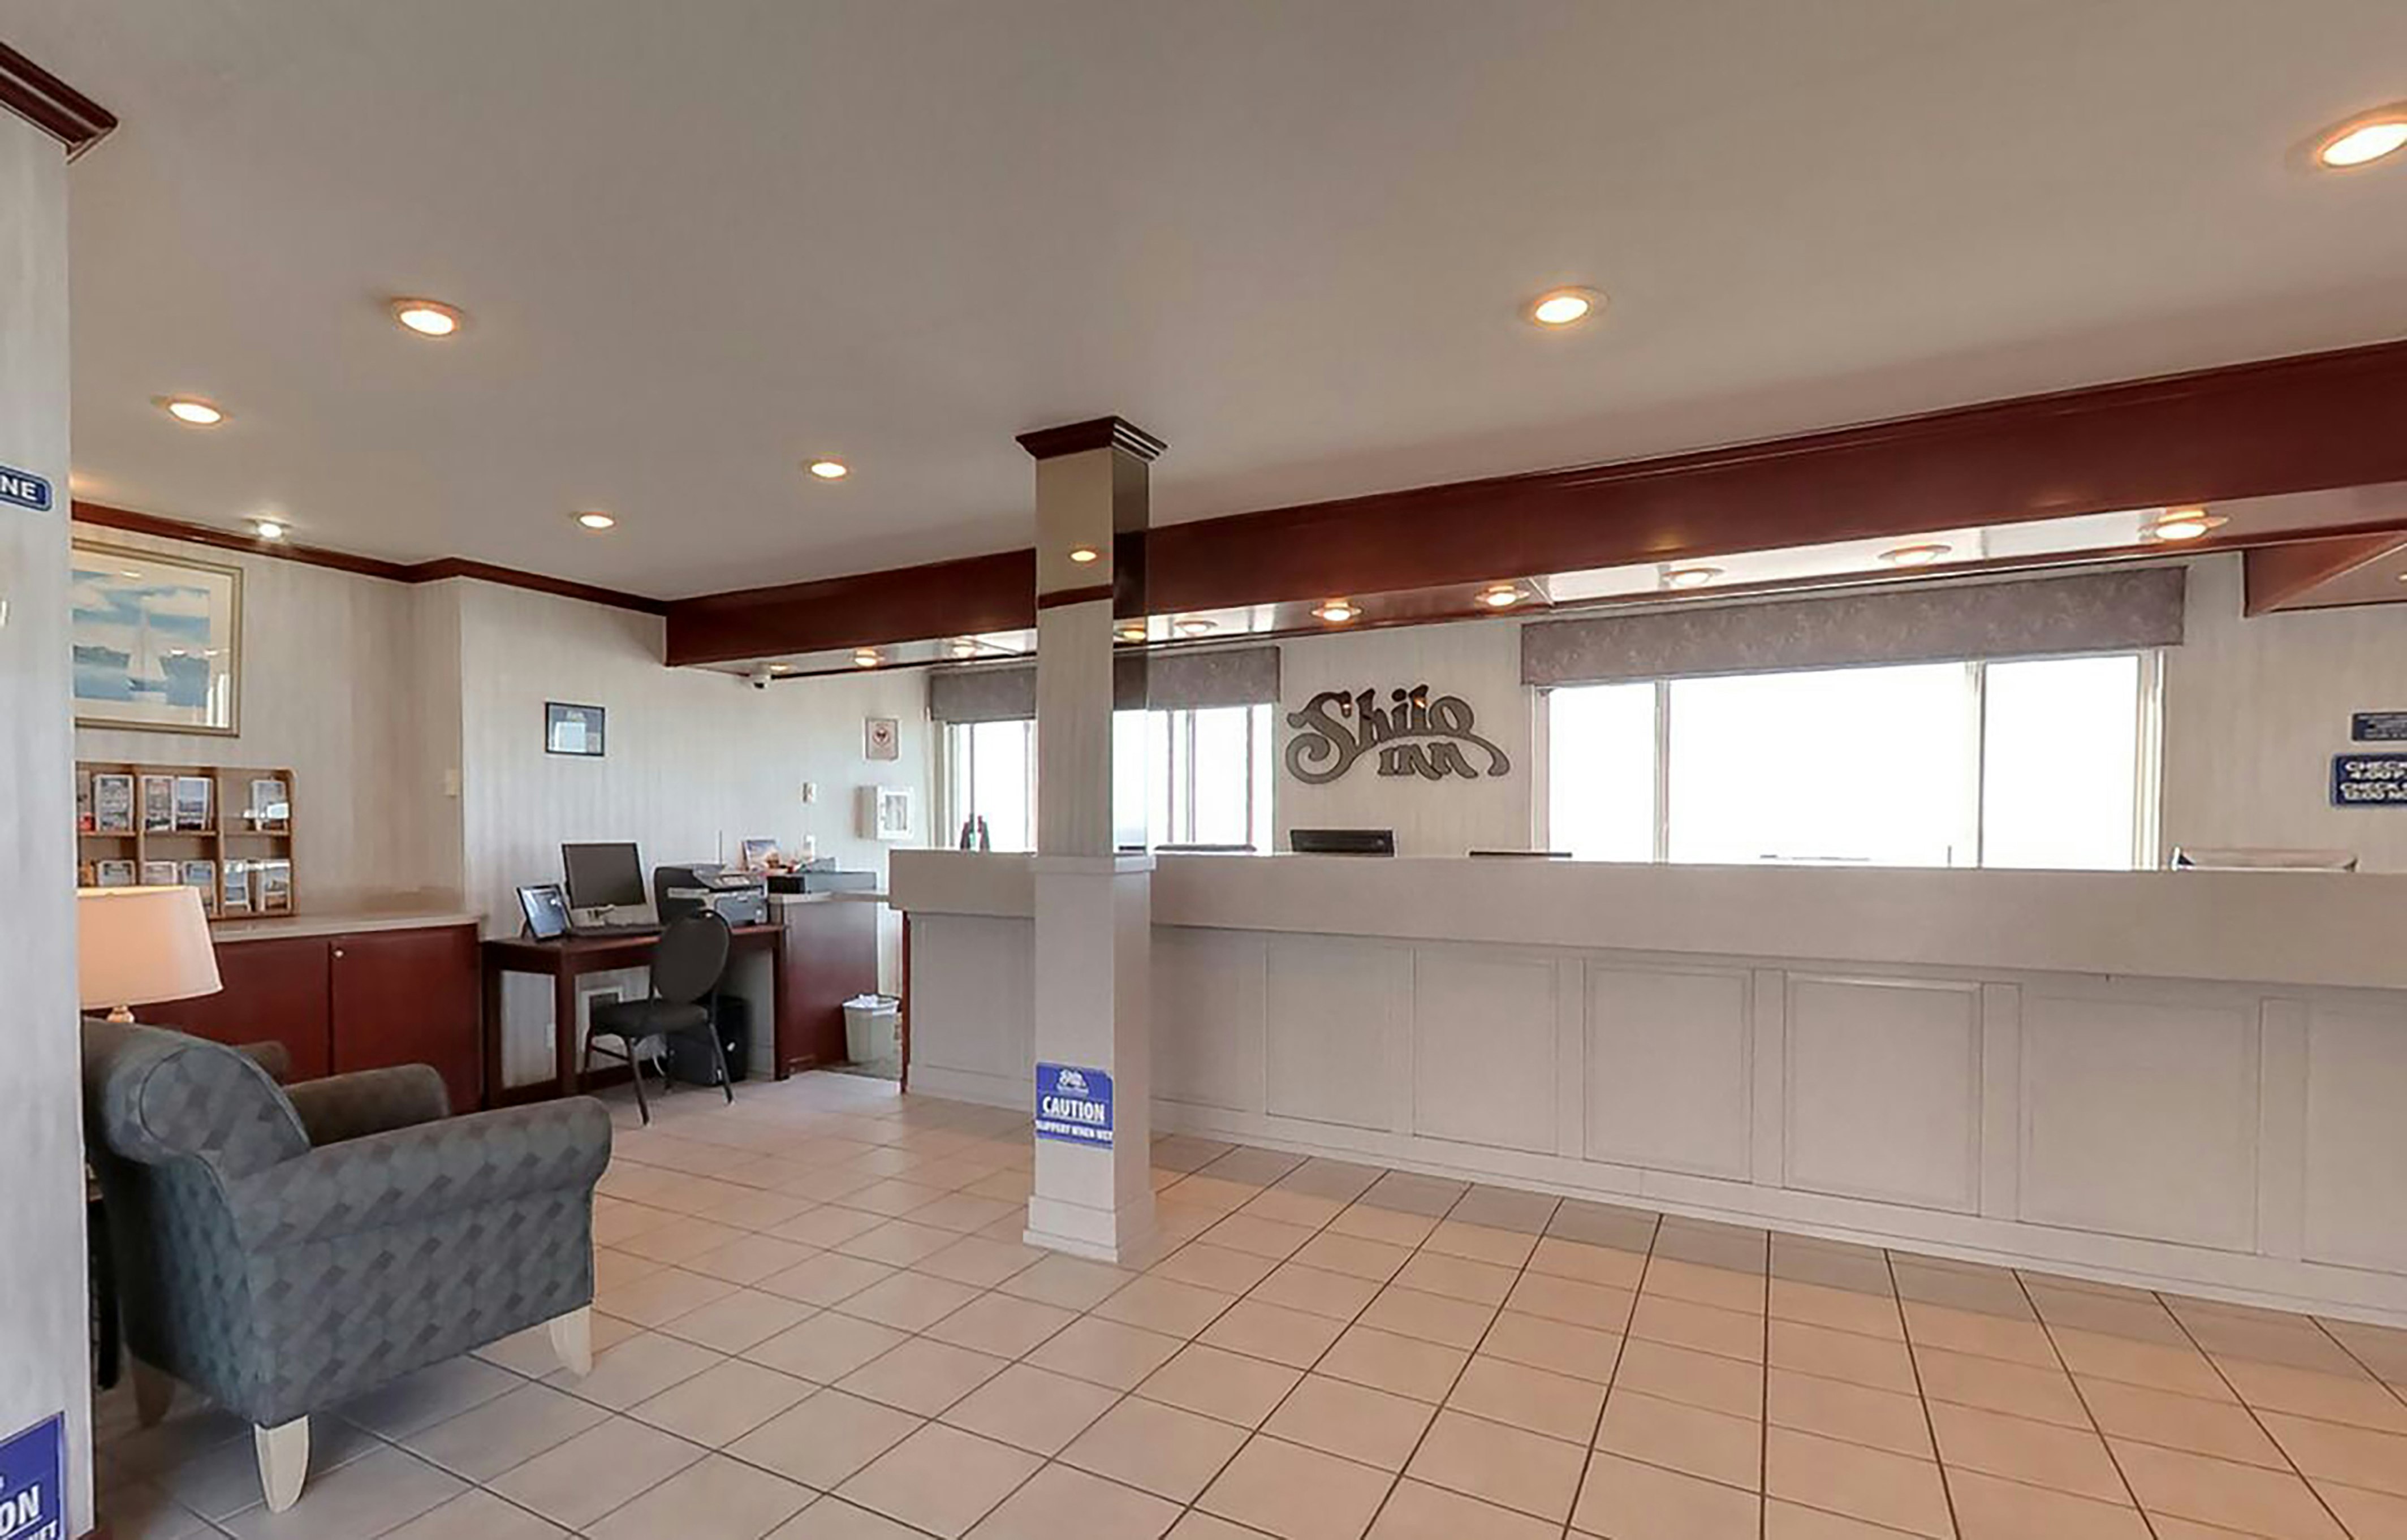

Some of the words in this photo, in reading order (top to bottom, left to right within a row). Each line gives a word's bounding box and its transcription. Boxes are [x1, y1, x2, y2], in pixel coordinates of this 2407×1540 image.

[1286, 684, 1511, 784] Shilo
[1043, 1096, 1105, 1121] CAUTION
[1072, 1126, 1095, 1138] WHEN
